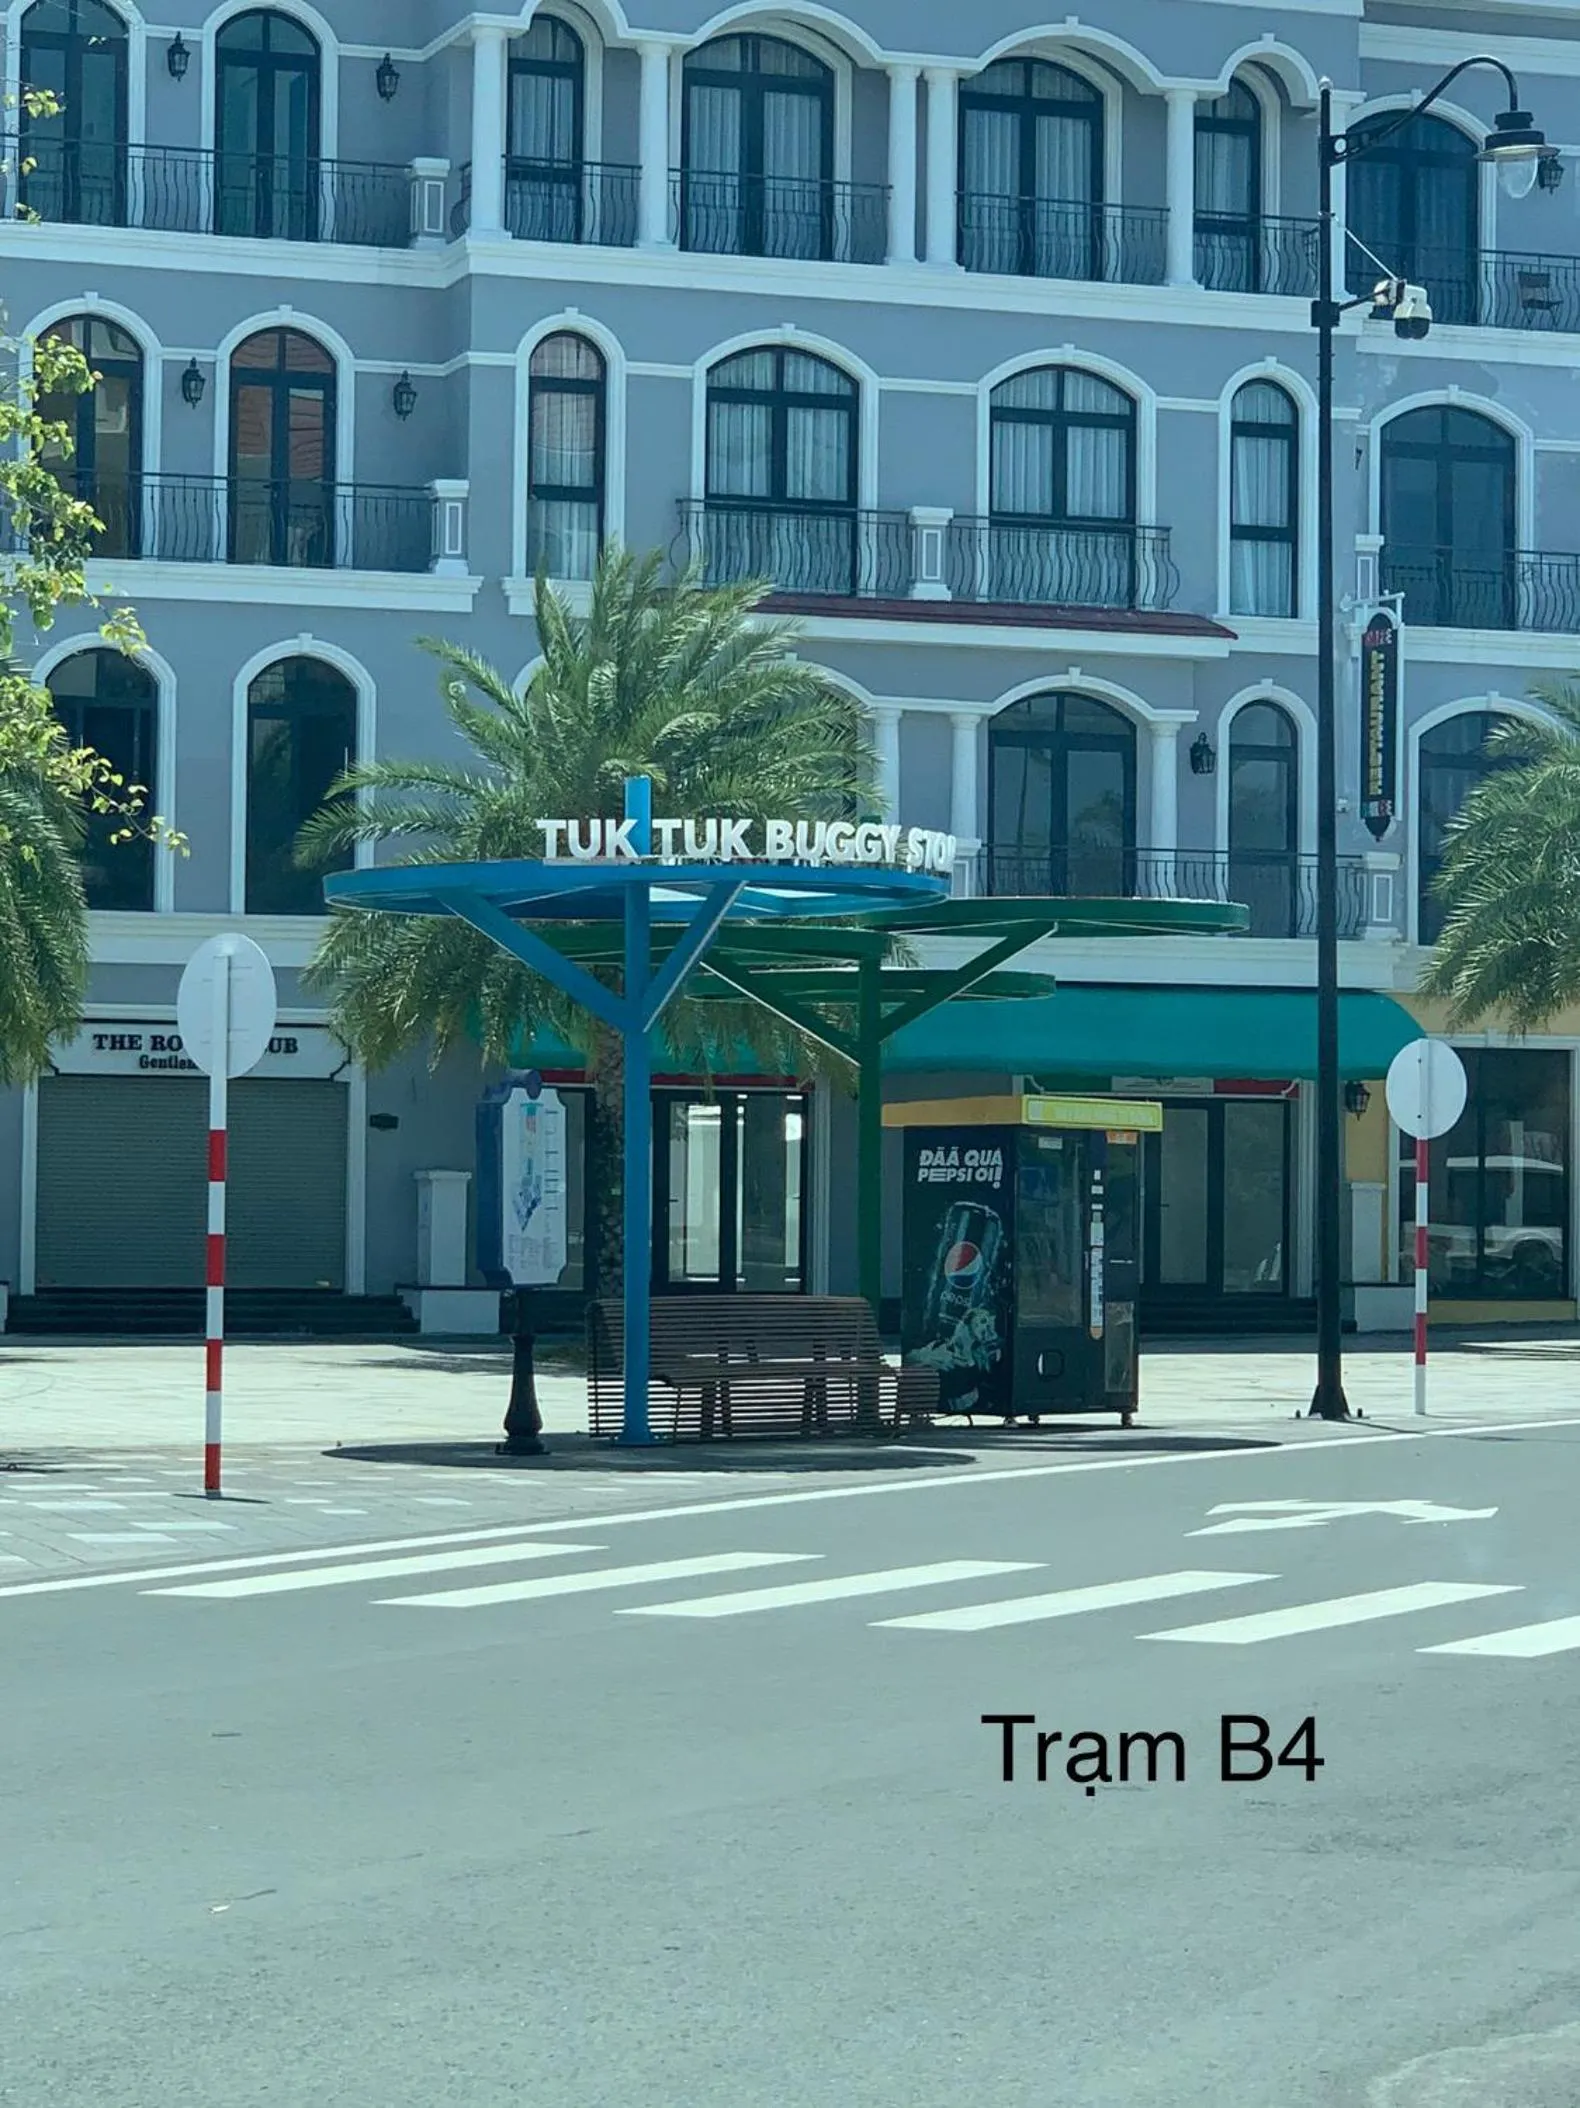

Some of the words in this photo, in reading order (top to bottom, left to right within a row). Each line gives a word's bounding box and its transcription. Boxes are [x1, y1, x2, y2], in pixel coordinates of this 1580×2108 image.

[536, 818, 639, 859] TUK
[651, 818, 756, 862] TUK
[765, 819, 902, 865] BUGGY
[93, 1034, 142, 1051] THE
[150, 1034, 184, 1052] RO
[268, 1036, 299, 1054] UB
[917, 1167, 973, 1183] PEPSI
